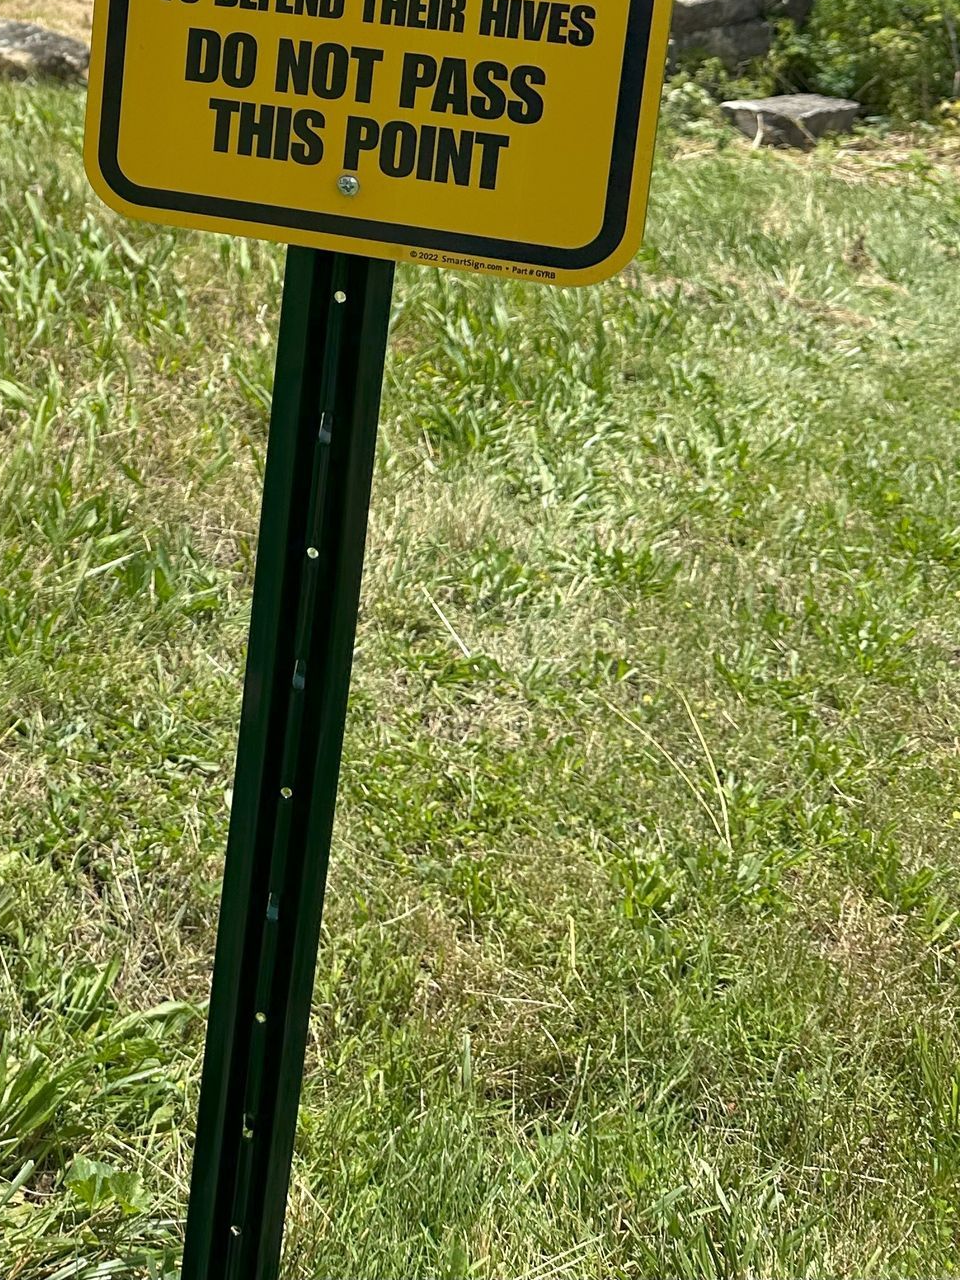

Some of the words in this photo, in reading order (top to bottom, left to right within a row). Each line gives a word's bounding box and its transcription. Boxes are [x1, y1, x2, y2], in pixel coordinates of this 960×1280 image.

[185, 27, 258, 88] DO
[275, 38, 383, 103] NOT
[399, 52, 547, 124] PASS
[209, 98, 325, 166] THIS
[343, 116, 510, 190] POINT
[418, 252, 438, 262] 2022
[442, 255, 502, 270] SmartSign.com
